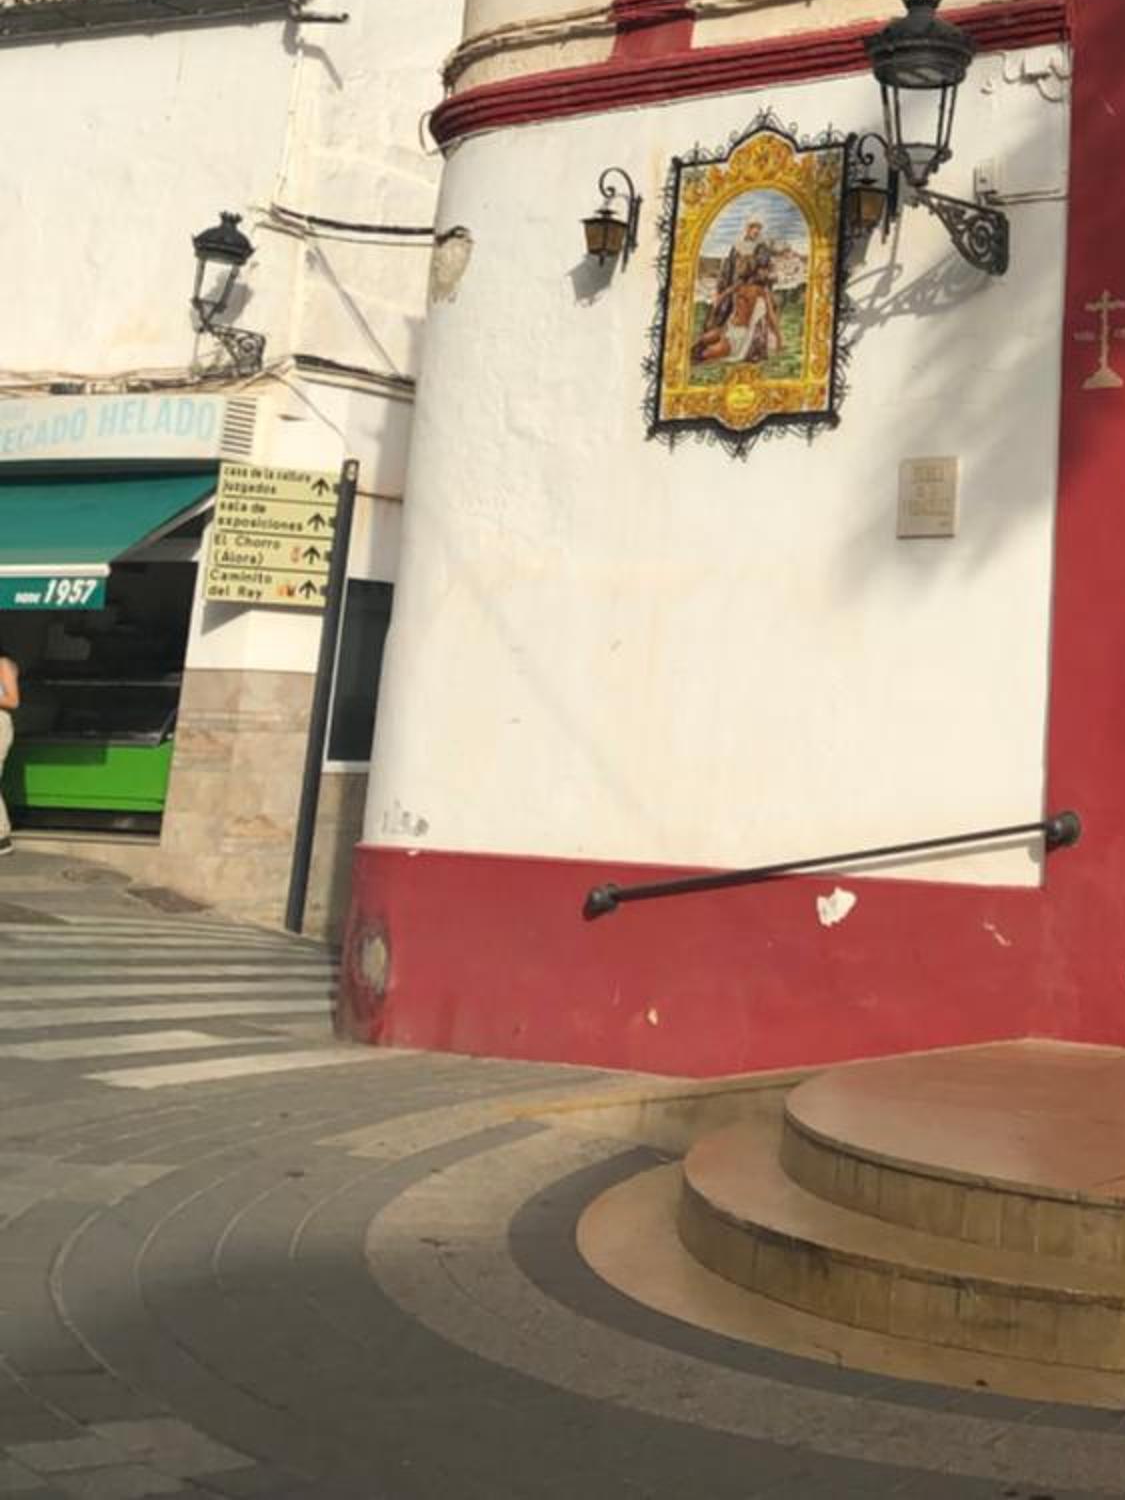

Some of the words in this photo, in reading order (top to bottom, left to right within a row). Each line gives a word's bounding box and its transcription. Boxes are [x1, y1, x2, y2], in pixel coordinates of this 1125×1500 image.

[97, 397, 217, 441] HELADO
[224, 466, 247, 477] casa
[251, 467, 262, 478] de
[264, 467, 274, 480] la
[219, 500, 247, 512] sala
[251, 503, 266, 514] de
[217, 516, 303, 532] exposiciones
[214, 534, 227, 545] El
[234, 535, 281, 550] Chorro
[209, 567, 273, 584] Caminito
[44, 579, 97, 606] 1957
[207, 584, 230, 596] del
